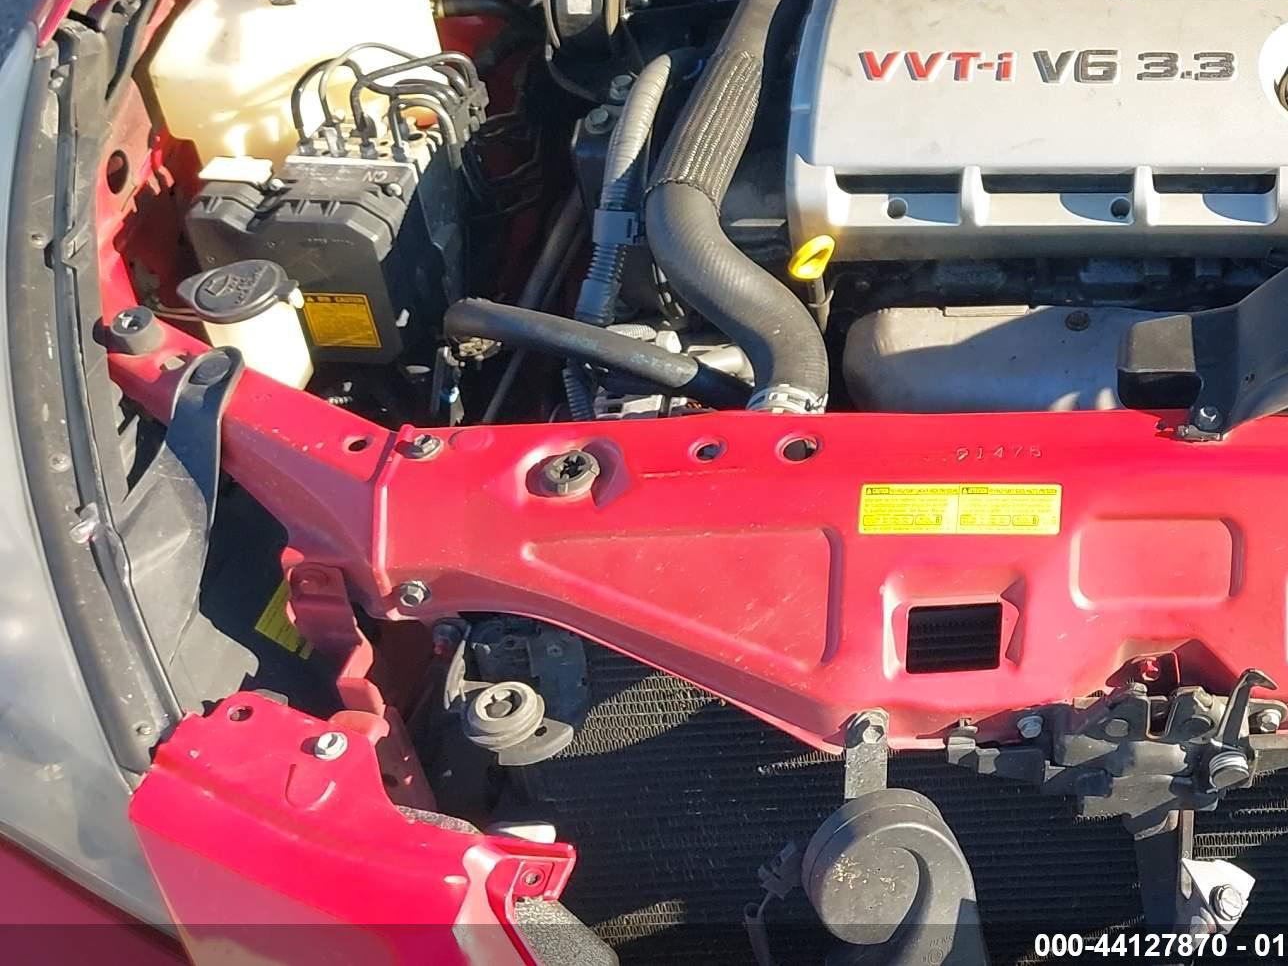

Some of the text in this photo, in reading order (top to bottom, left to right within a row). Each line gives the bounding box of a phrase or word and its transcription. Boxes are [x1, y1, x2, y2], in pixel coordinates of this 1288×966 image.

[858, 48, 1236, 84] VVT-i V6 3.3
